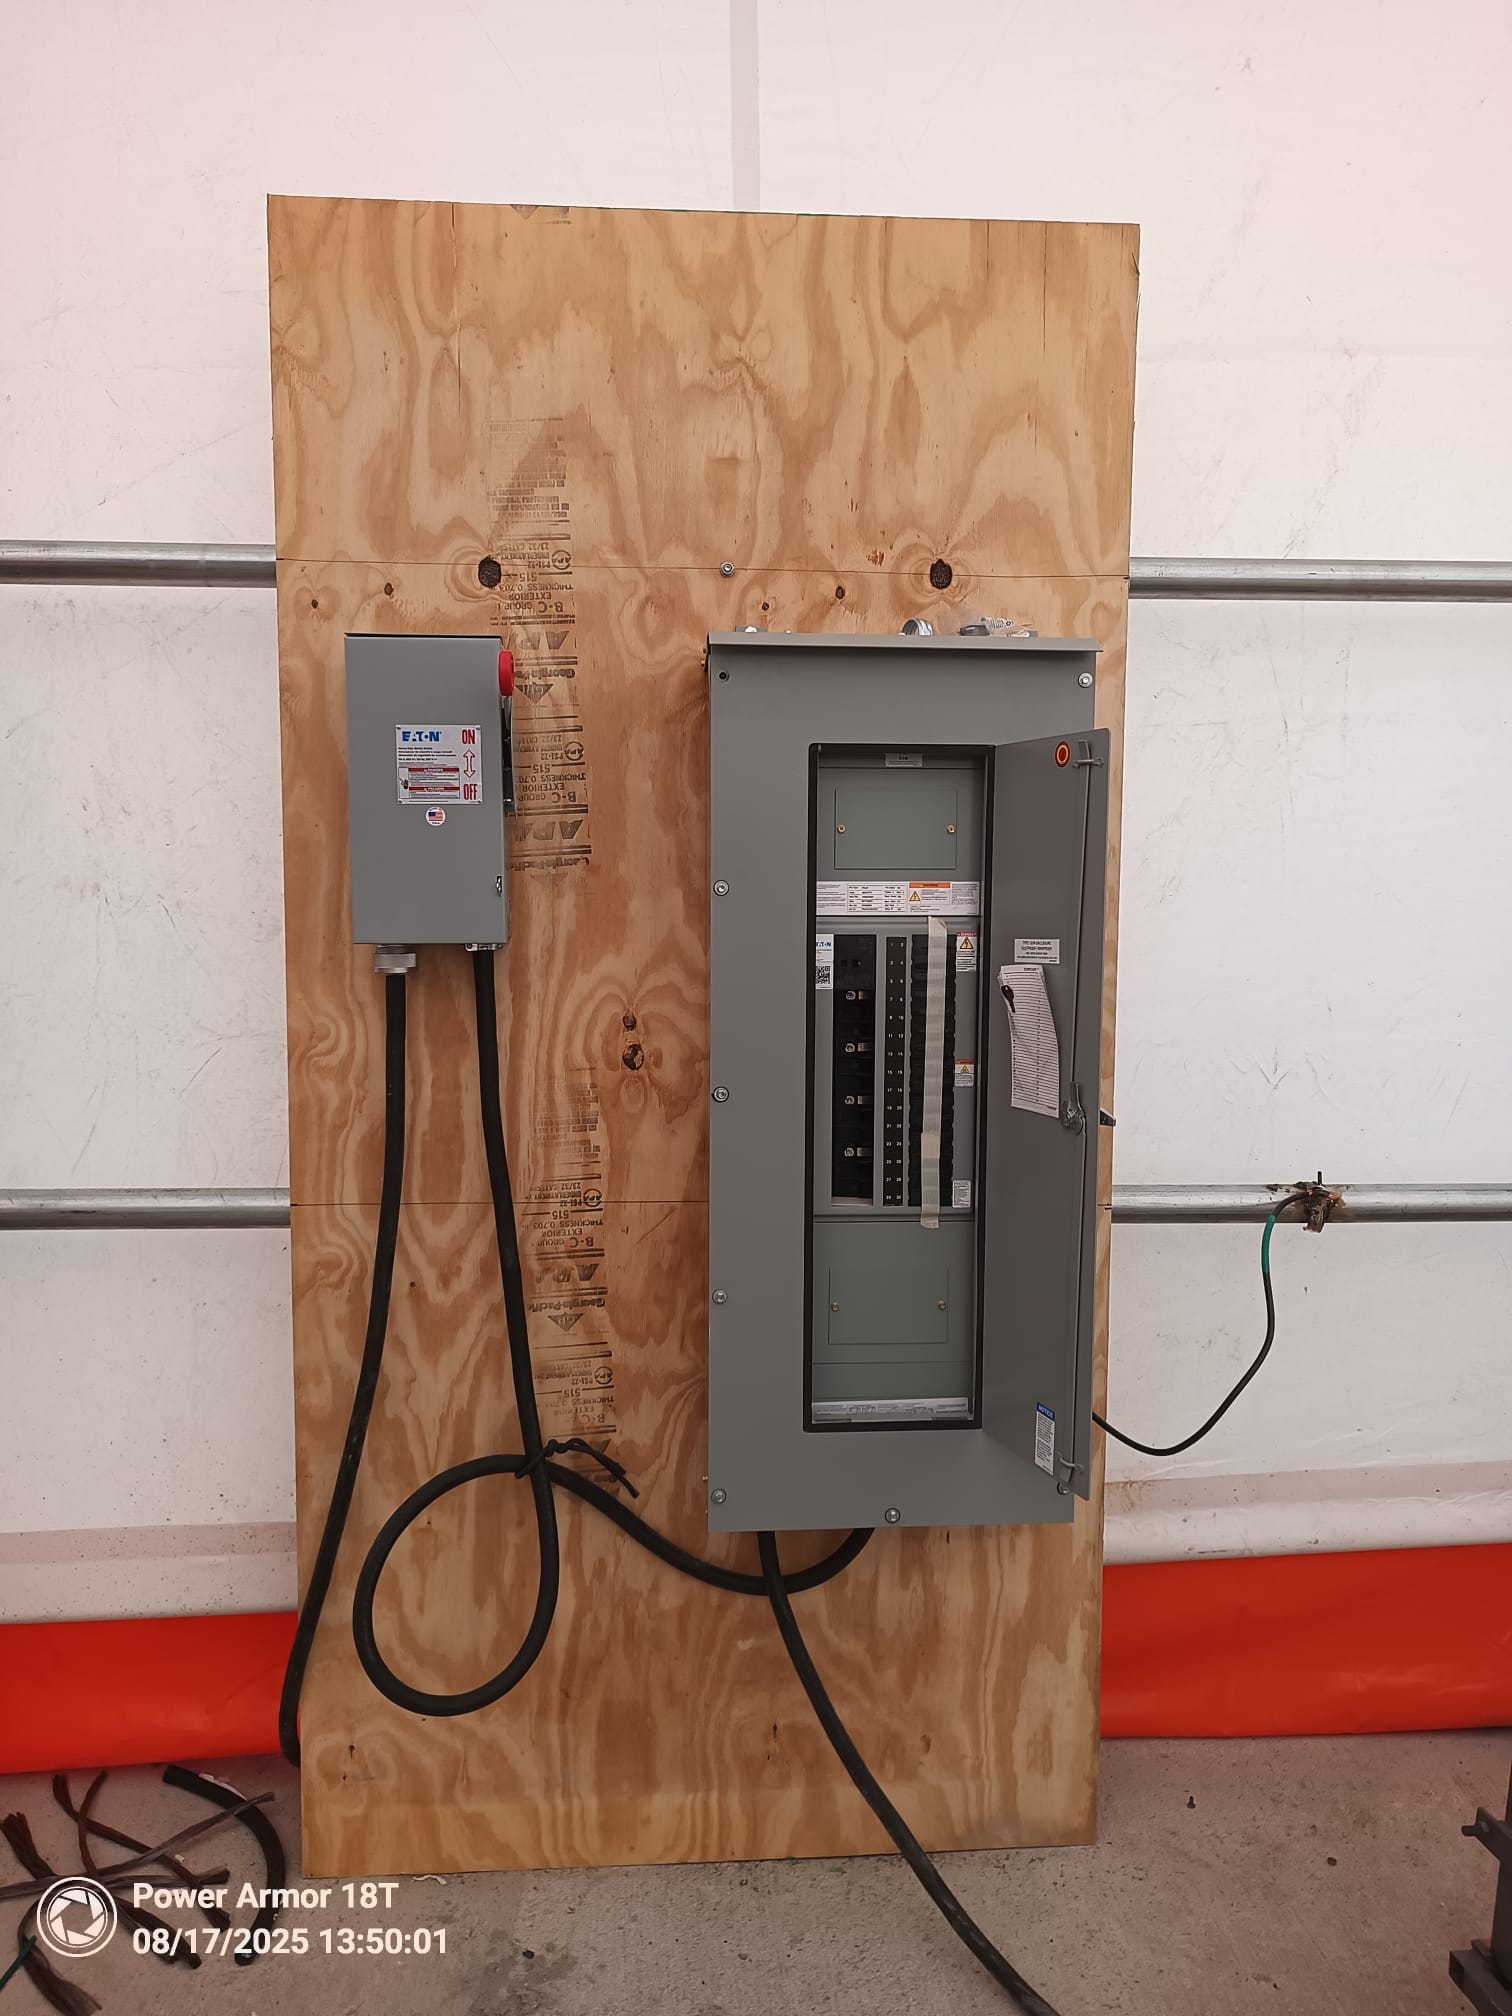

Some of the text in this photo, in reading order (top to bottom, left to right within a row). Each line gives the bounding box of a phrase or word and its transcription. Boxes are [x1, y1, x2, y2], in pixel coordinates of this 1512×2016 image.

[519, 572, 538, 582] 515
[527, 582, 574, 591] THICKNESS
[508, 592, 552, 600] EXTERIOR
[504, 602, 532, 610] GROUP
[538, 601, 564, 613] B-C
[462, 729, 476, 745] ON
[532, 764, 552, 774] 515
[540, 772, 586, 782] THICKNESS
[522, 782, 564, 791] EXTERIOR
[463, 784, 478, 800] OFF
[518, 791, 577, 803] B-C GROUP
[552, 1210, 569, 1220] 515
[542, 1228, 582, 1238] EXTERIOR
[570, 1236, 594, 1248] B-C
[594, 1371, 613, 1380] APA
[564, 1387, 581, 1398] 515
[581, 1412, 606, 1424] B-C
